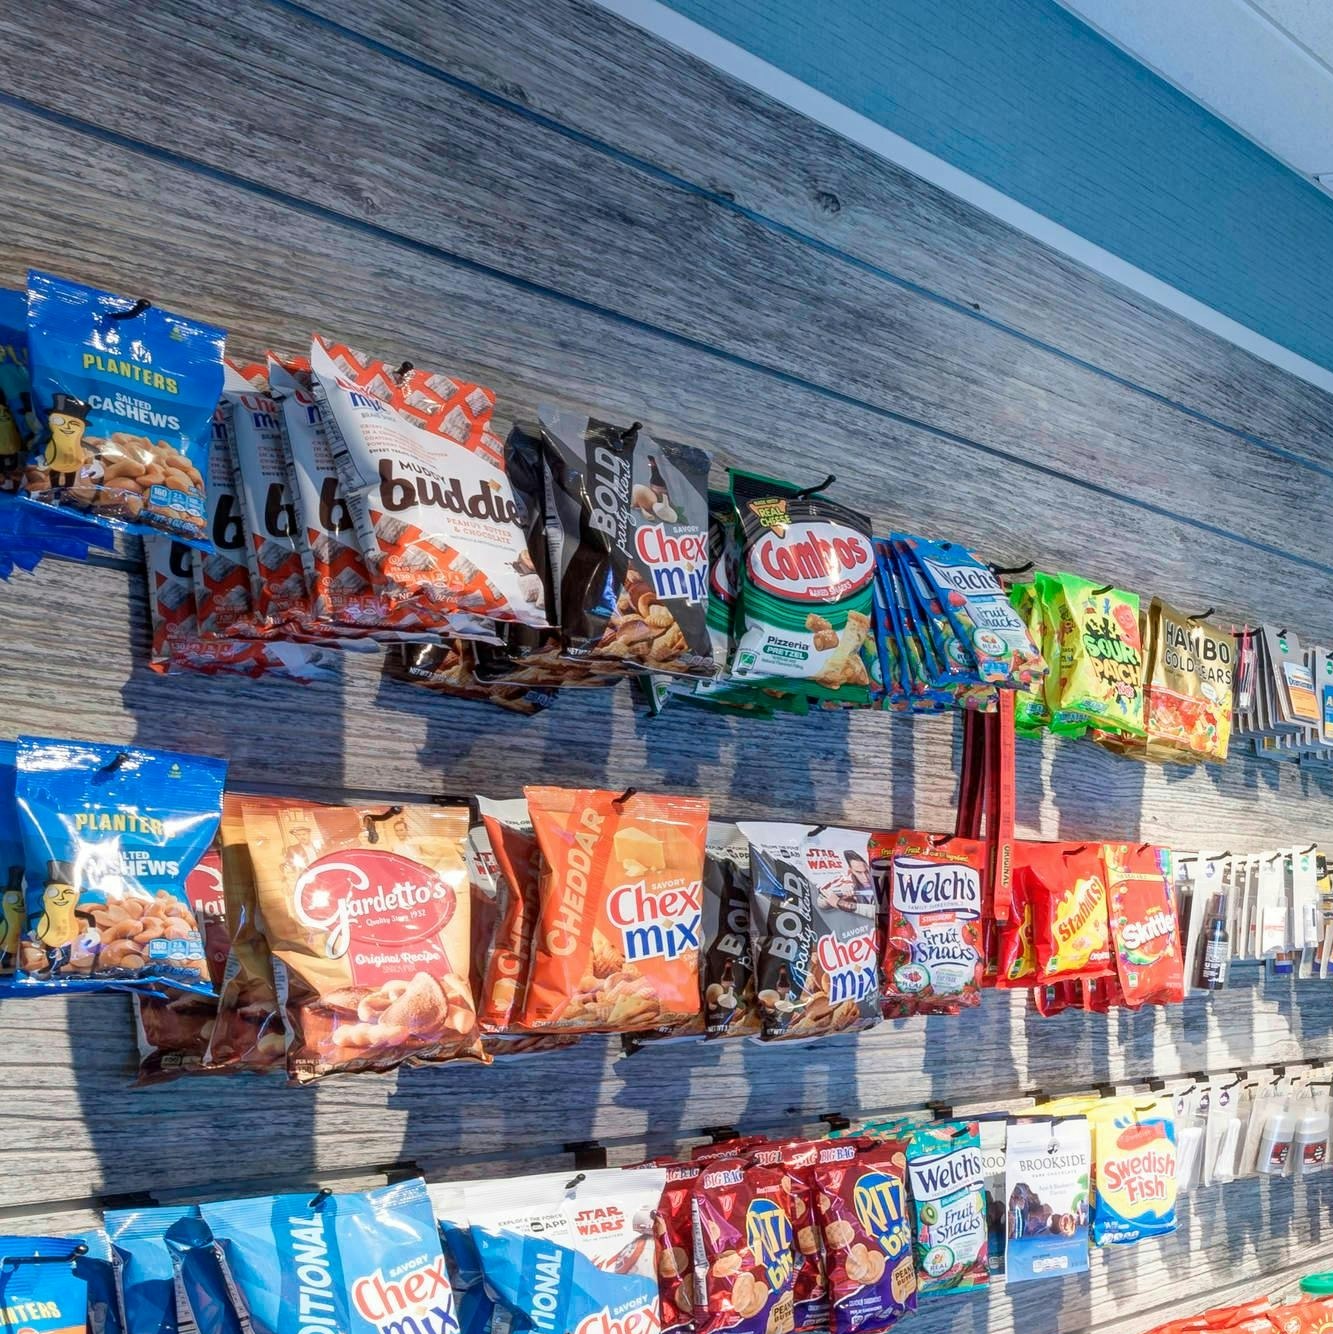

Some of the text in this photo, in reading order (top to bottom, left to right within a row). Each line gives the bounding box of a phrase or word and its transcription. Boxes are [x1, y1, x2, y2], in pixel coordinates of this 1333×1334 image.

[82, 353, 180, 395] PLANTERS
[88, 394, 181, 431] CASHEWS
[116, 392, 152, 412] SALTED
[399, 460, 446, 485] MUDDY
[379, 459, 527, 530] buddie
[589, 447, 626, 542] BOLD
[758, 505, 785, 518] REAL
[635, 525, 707, 568] Chex
[760, 529, 868, 581] Combos
[654, 563, 707, 604] mix
[936, 564, 998, 593] Welch's
[767, 635, 810, 652] Pizzeria
[768, 646, 807, 660] PRETZEL
[1084, 632, 1139, 667] SOUR
[1089, 656, 1141, 688] PATCH
[805, 846, 838, 860] STAR
[807, 857, 844, 871] WARS
[1001, 845, 1011, 888] ORIGINAL
[547, 807, 604, 957] CHEDDAR
[651, 877, 687, 892] SAVORY
[897, 871, 977, 904] Welch's
[296, 861, 448, 960] Gardetto's
[409, 909, 427, 922] 1932
[610, 881, 701, 927] Chex
[769, 872, 802, 957] BOLD
[625, 915, 701, 962] mix
[841, 924, 870, 940] SAVORY
[922, 930, 959, 948] Fruit
[1121, 912, 1175, 950] Skittle
[354, 950, 441, 968] Original Recipe
[818, 932, 878, 975] Chex
[917, 944, 976, 964] Snacks
[831, 969, 877, 1005] mix
[915, 1154, 982, 1195] Welch's
[1019, 1153, 1087, 1172] BROOKSIDE
[1104, 1151, 1175, 1190] Swedish
[1126, 1176, 1166, 1204] Fish
[546, 1219, 567, 1233] APP
[575, 1207, 622, 1224] STAR
[577, 1219, 625, 1236] WARS
[936, 1215, 981, 1242] Snacks
[943, 1205, 974, 1225] Fruit
[389, 1253, 429, 1278] SAVORY
[354, 1256, 452, 1322] Chex
[613, 1294, 649, 1318] SAVORY
